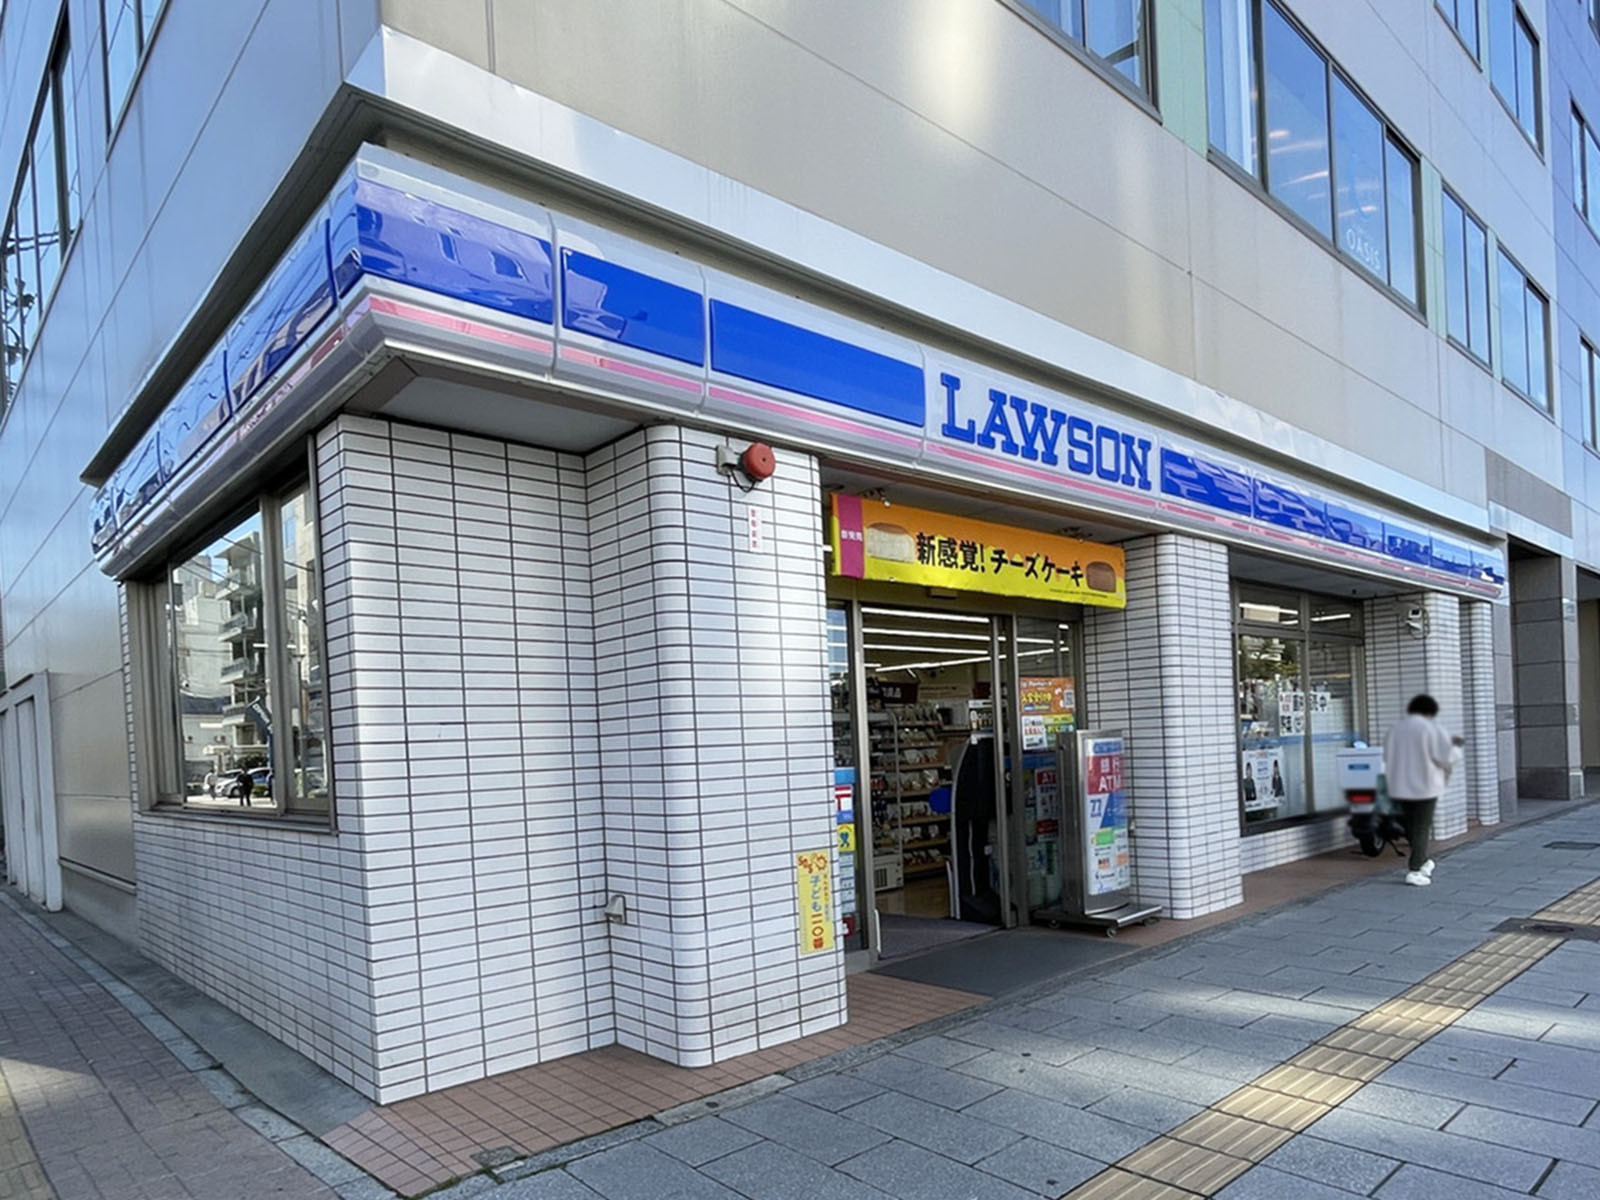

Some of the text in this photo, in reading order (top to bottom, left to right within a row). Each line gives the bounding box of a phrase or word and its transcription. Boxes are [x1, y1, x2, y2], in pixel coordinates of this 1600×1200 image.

[1346, 228, 1381, 270] OASIS
[940, 372, 1152, 491] LAWSON
[1098, 775, 1121, 792] ATM
